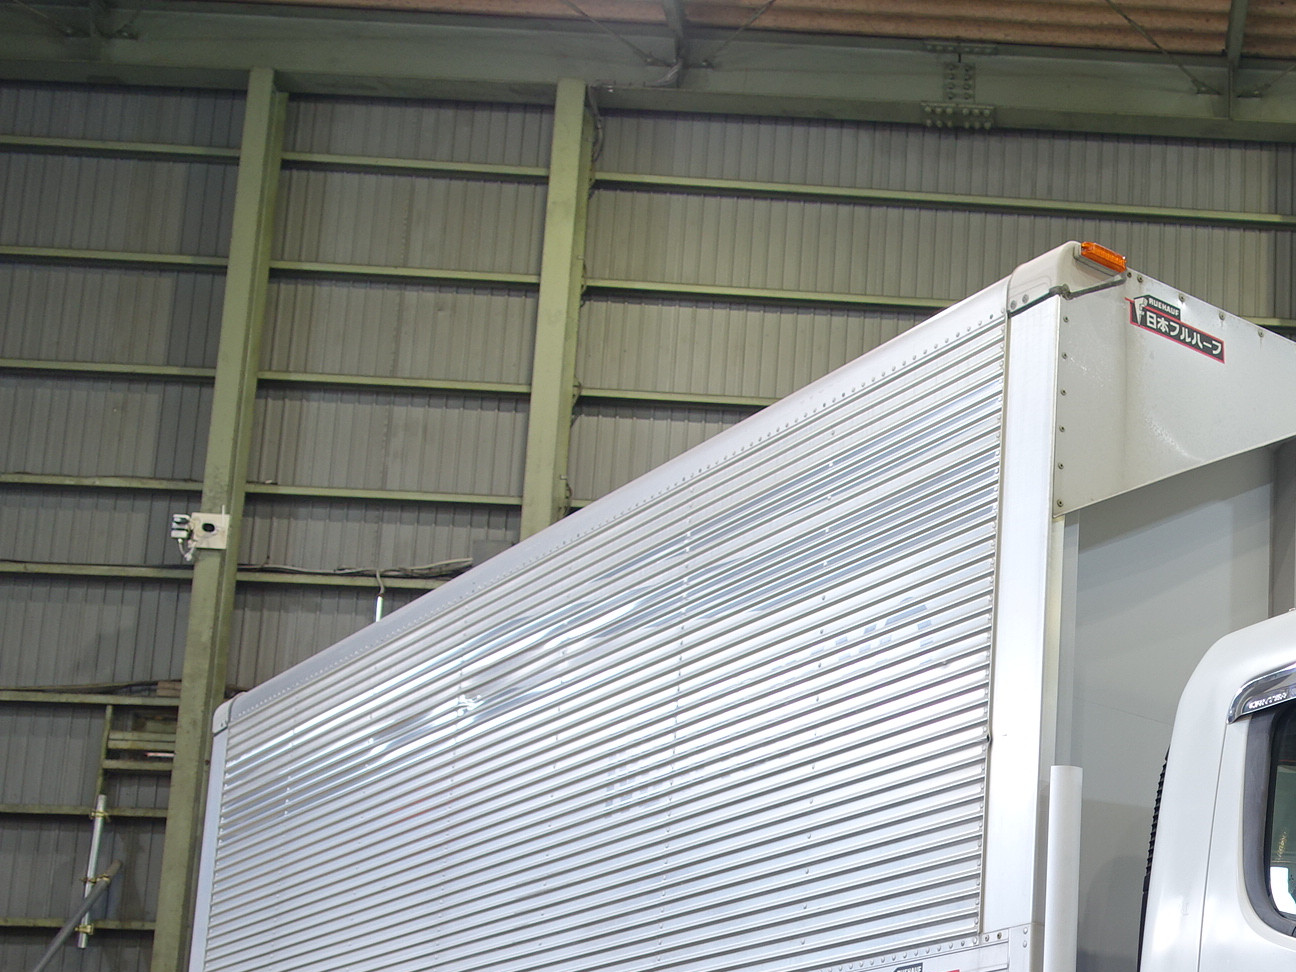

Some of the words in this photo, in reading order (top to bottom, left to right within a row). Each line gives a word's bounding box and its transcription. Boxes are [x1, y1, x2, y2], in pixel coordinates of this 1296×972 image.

[1146, 311, 1222, 355] 日本フルハーフ
